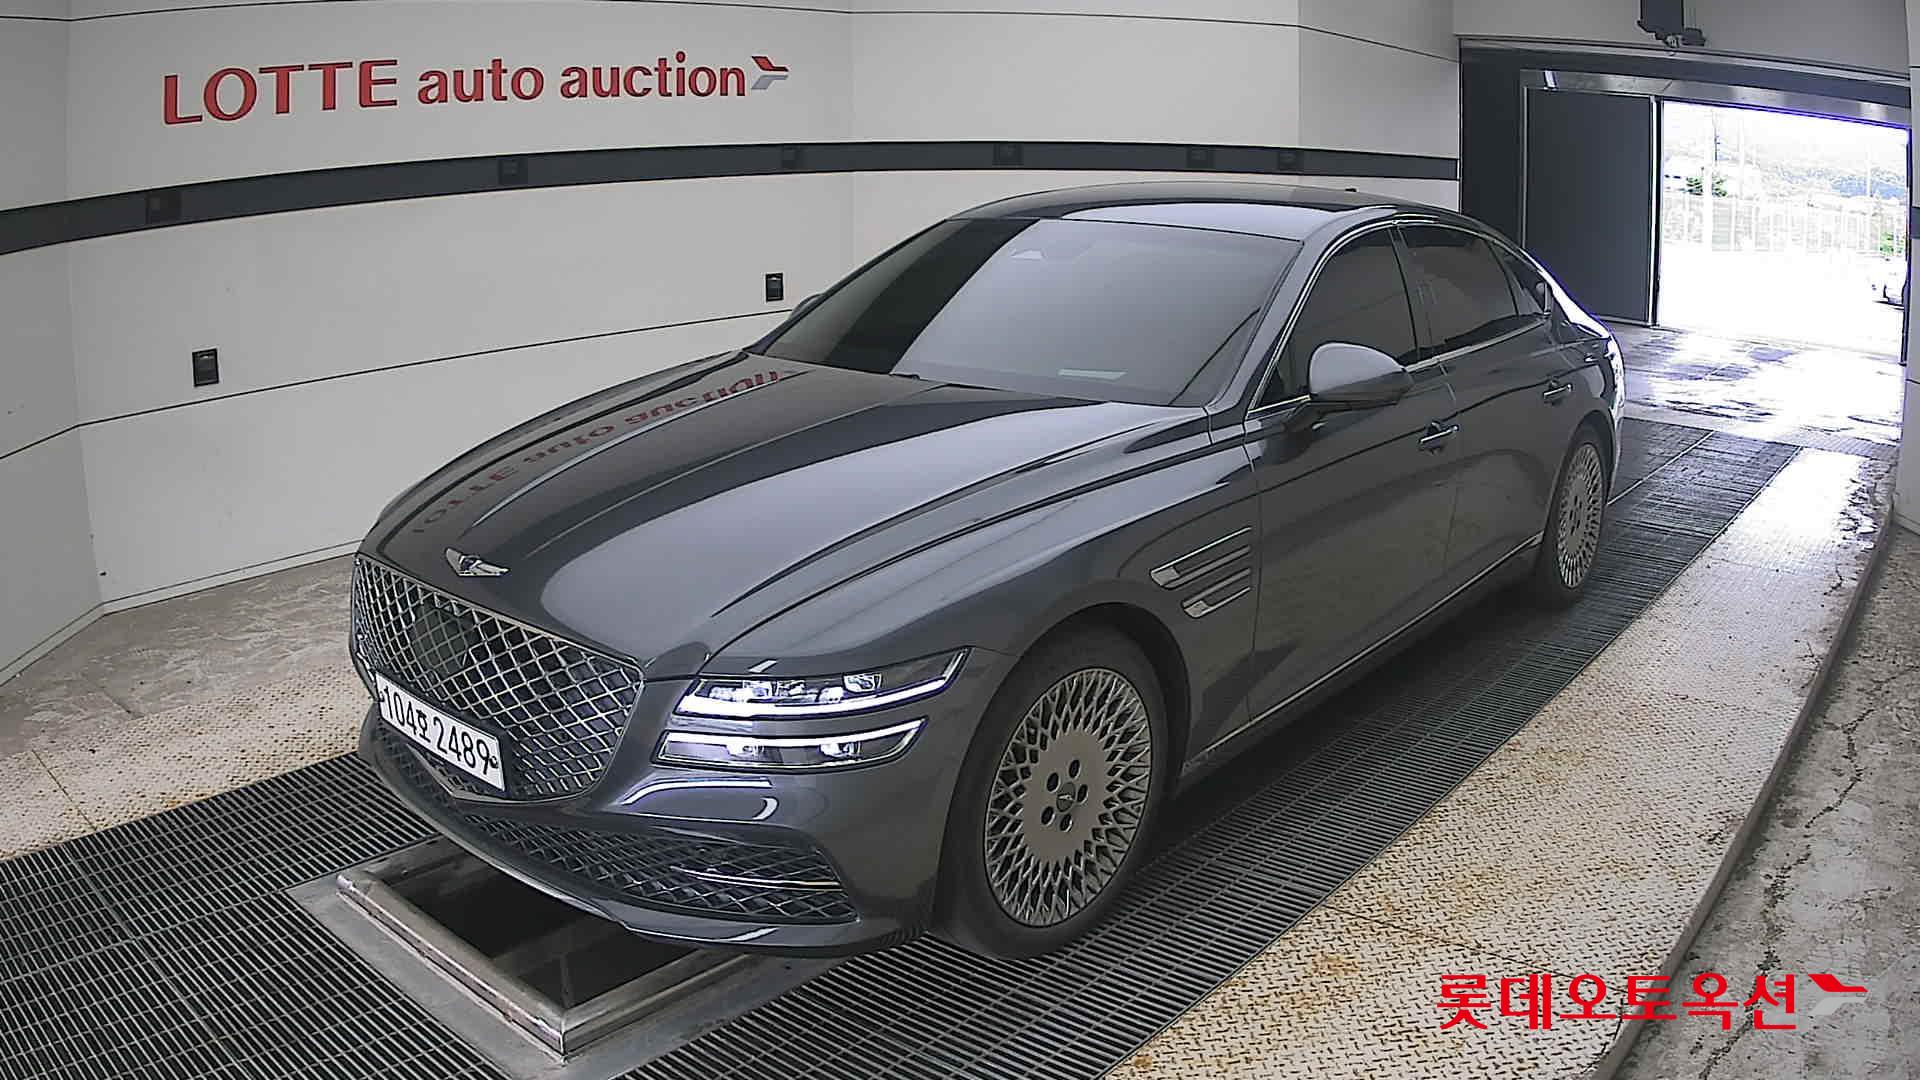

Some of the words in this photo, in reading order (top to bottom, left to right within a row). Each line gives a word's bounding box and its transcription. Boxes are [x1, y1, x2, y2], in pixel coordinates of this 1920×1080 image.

[163, 59, 398, 125] LOTTE
[417, 58, 544, 105] auto
[560, 51, 746, 99] auction
[433, 716, 491, 775] 2489
